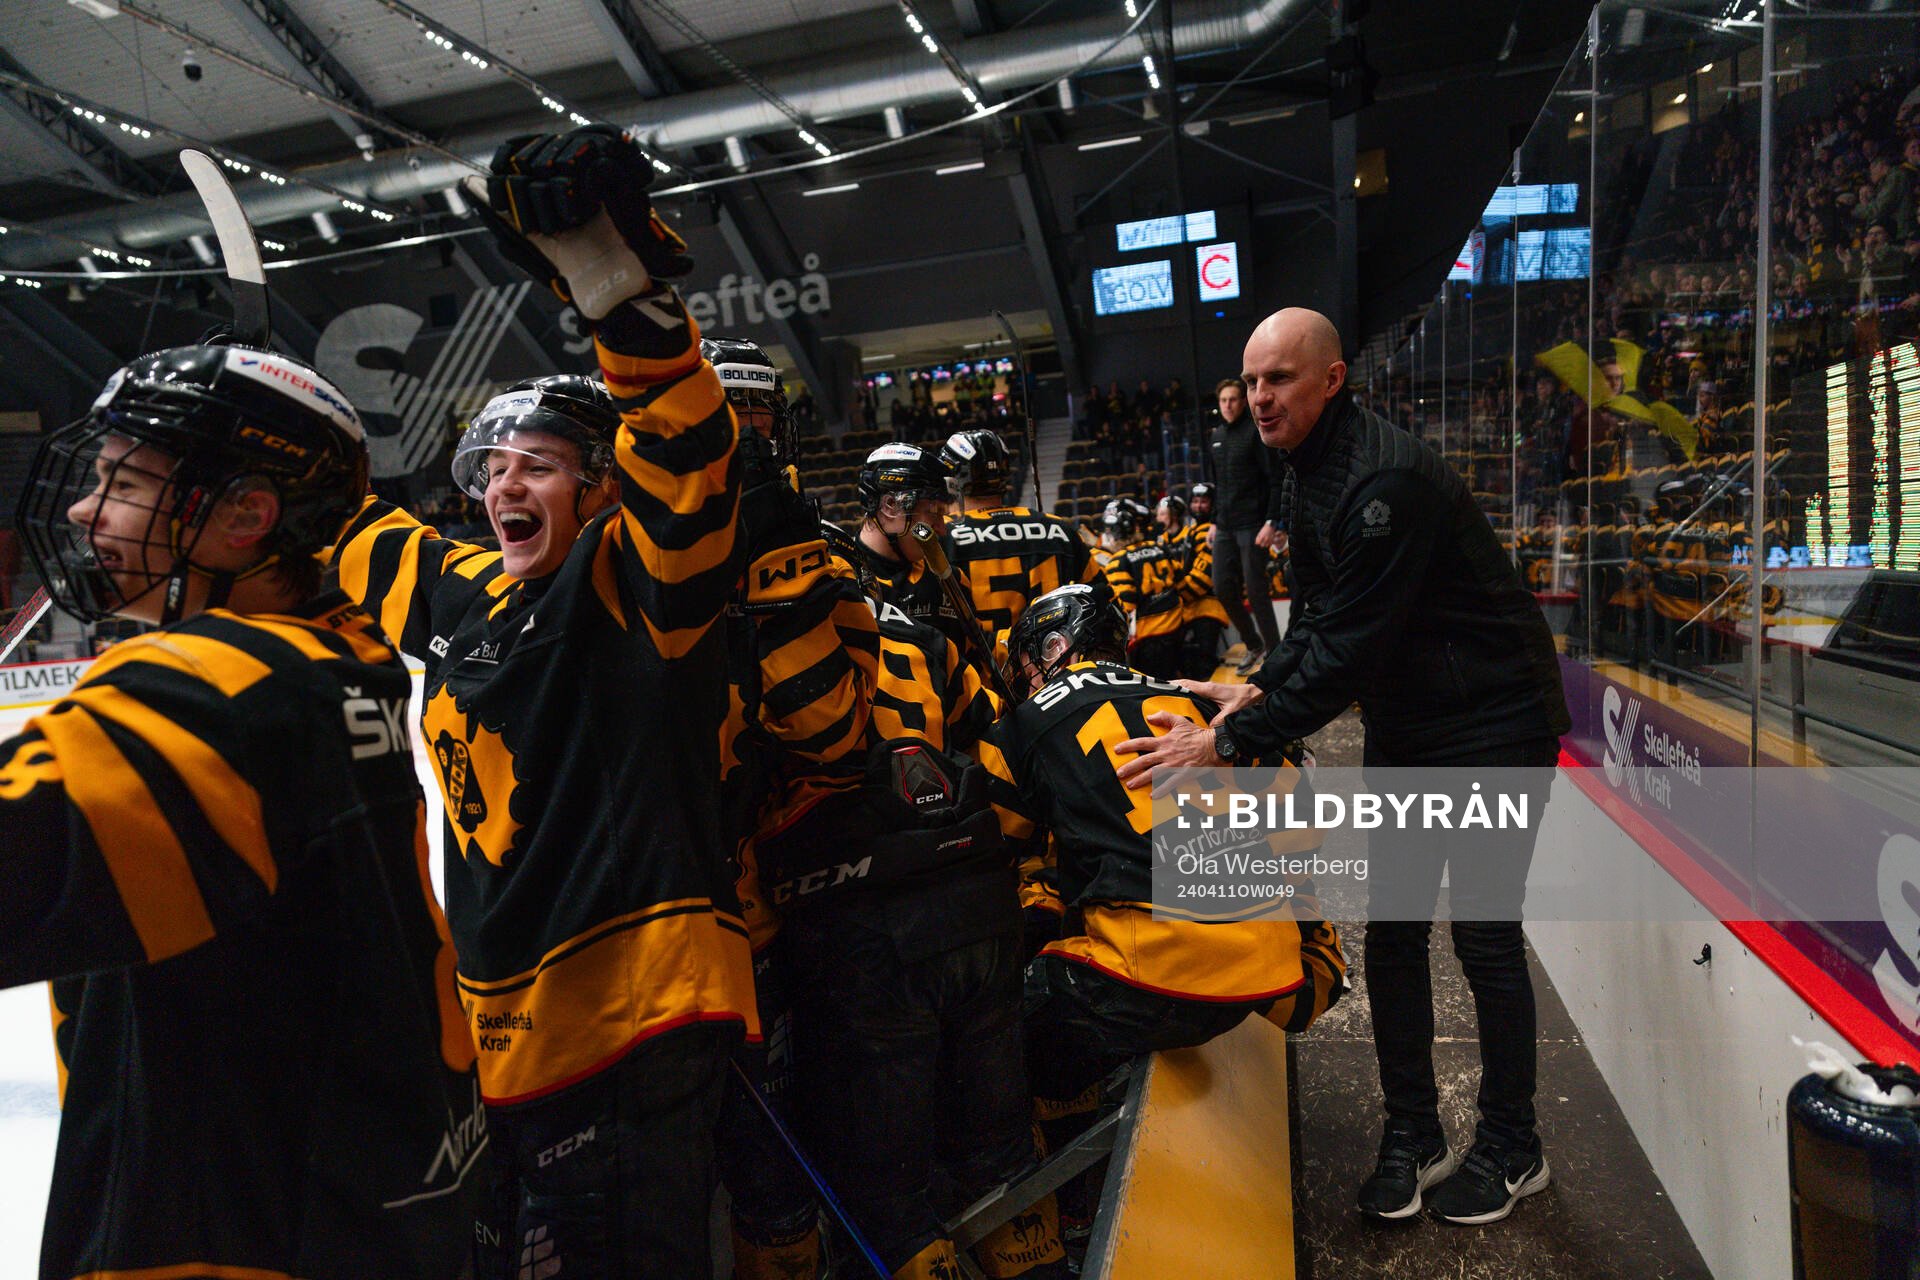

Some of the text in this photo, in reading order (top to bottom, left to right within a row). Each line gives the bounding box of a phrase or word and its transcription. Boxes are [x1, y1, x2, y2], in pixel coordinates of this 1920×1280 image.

[260, 362, 356, 424] INTERSPORT
[723, 368, 774, 384] BOLIDEN
[951, 523, 1070, 546] ŠKODA
[1644, 723, 1702, 787] Skellefteå
[915, 792, 944, 805] CCM
[1644, 763, 1672, 810] Kraft
[773, 855, 873, 905] CCM
[479, 1034, 512, 1052] Kraft
[537, 1125, 596, 1168] CCM
